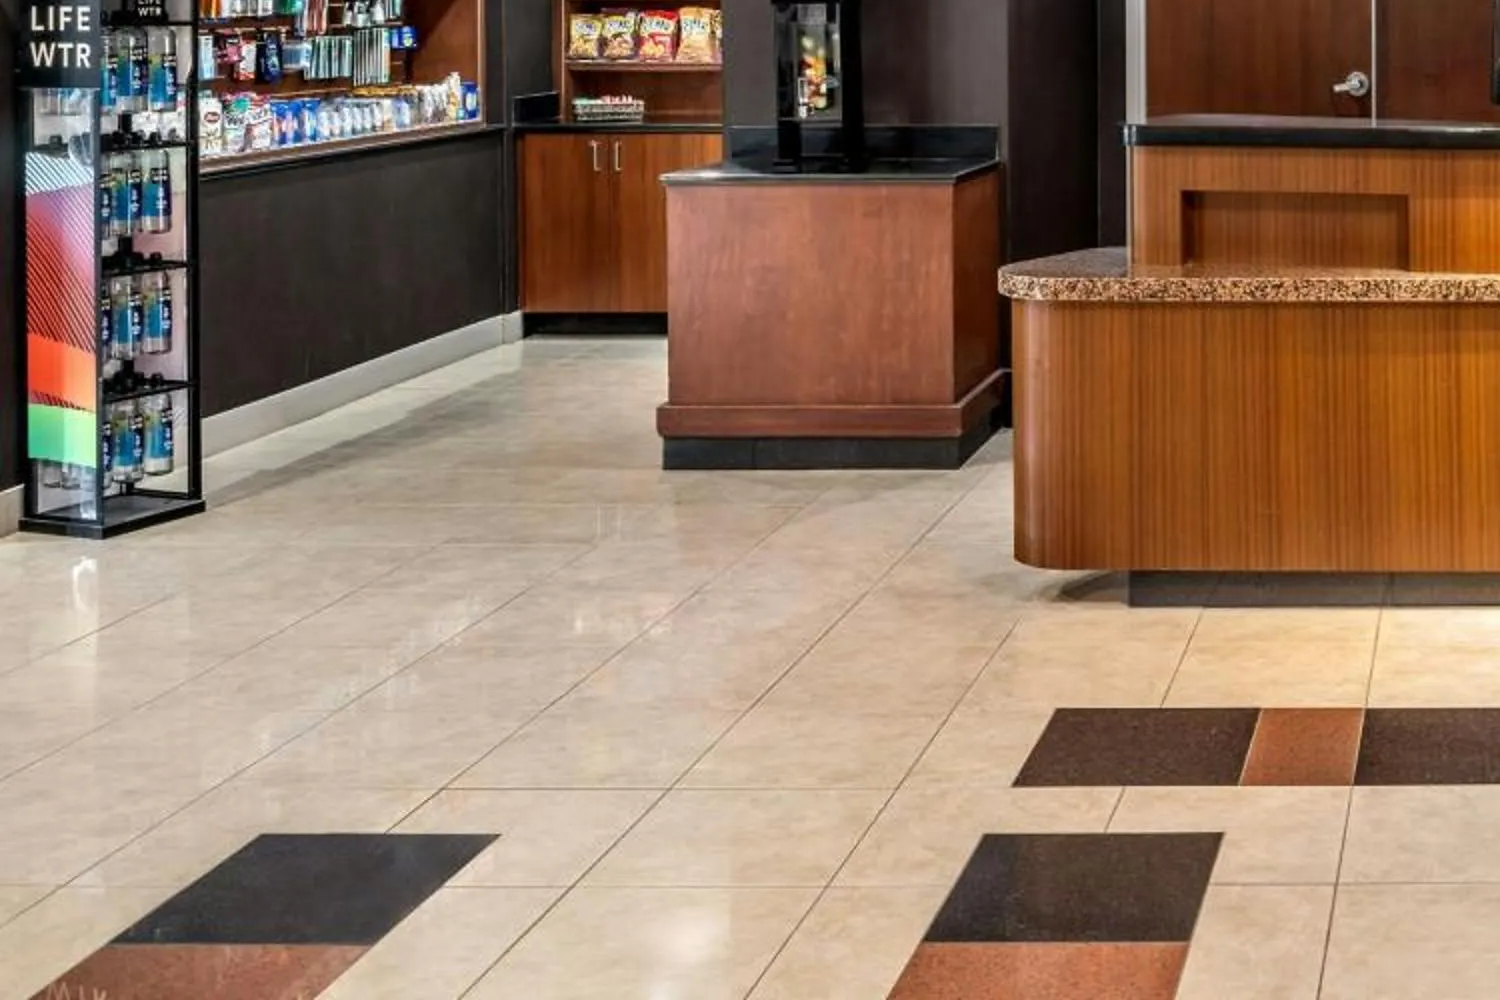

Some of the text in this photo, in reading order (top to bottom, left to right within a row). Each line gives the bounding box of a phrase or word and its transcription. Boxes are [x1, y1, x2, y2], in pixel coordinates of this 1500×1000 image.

[30, 5, 92, 32] LIFE
[137, 7, 162, 17] WTR
[29, 41, 92, 69] WTR
